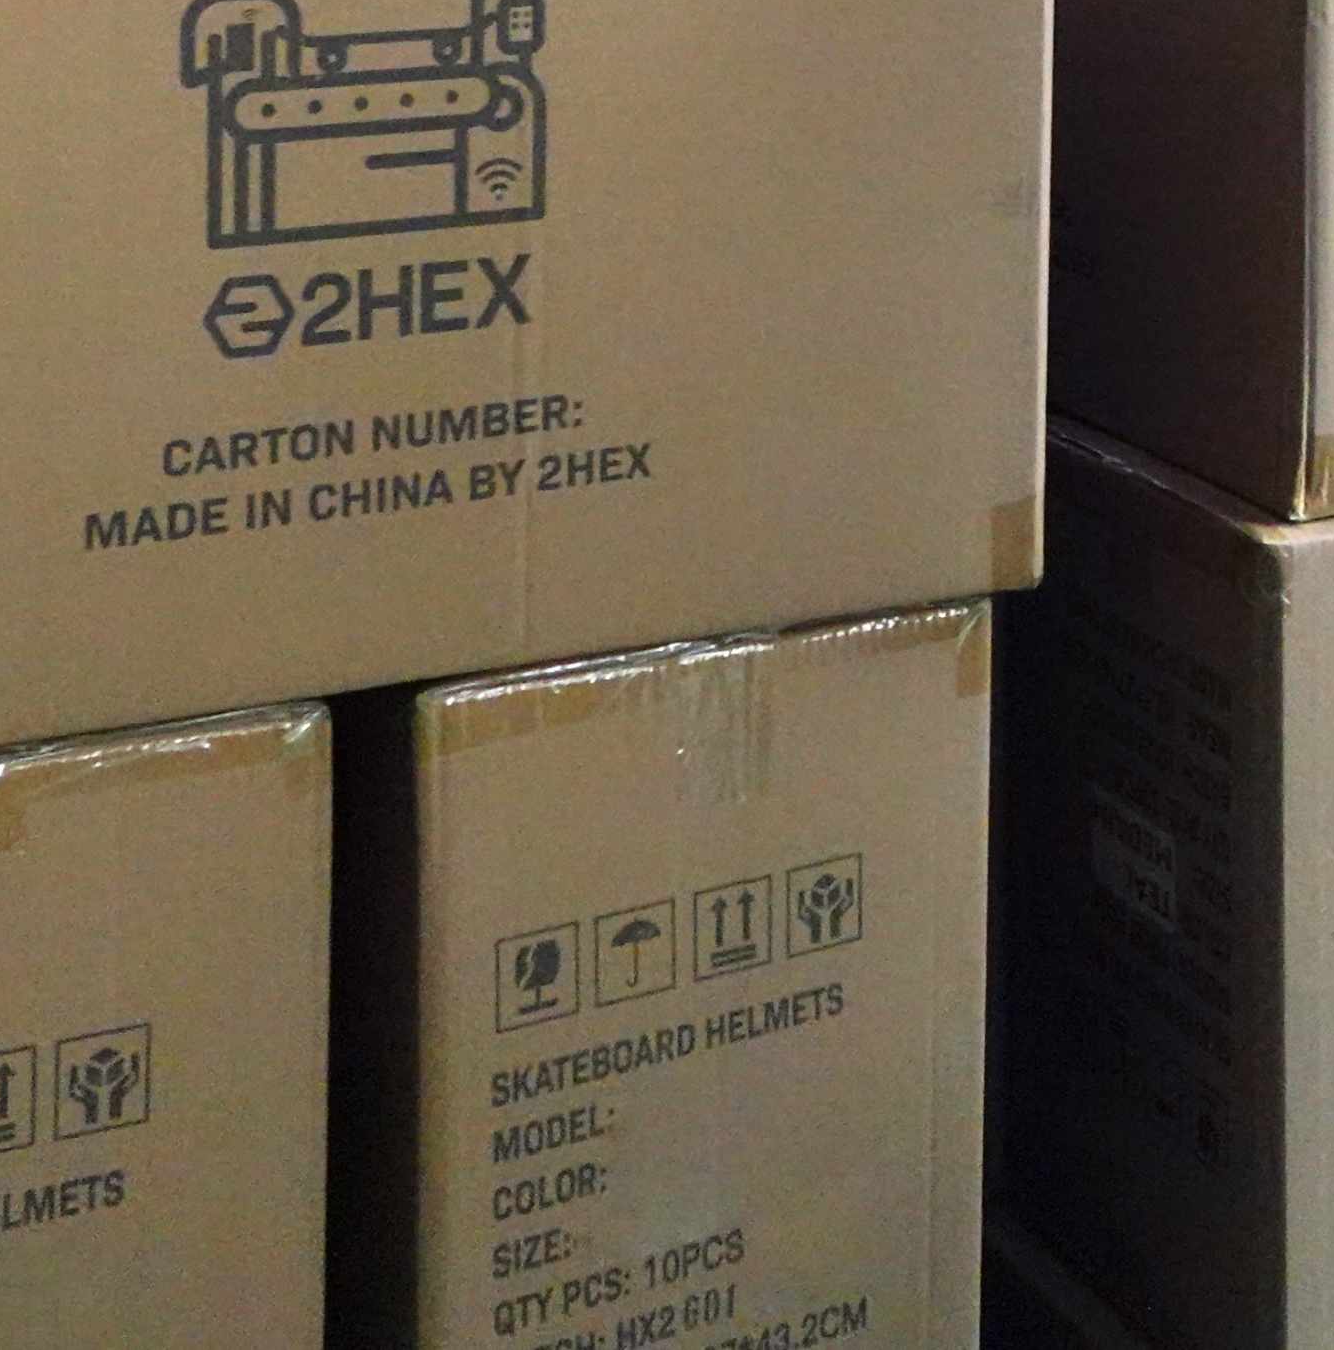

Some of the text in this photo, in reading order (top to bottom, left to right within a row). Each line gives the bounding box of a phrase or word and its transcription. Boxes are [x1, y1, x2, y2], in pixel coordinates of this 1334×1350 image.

[301, 254, 533, 346] 2HEX
[162, 394, 585, 478] CARTON NUMBER:
[85, 444, 653, 550] MADE IN CHINA BY 2HEX
[491, 983, 844, 1108] SKATEBOARD HELMETS
[492, 1104, 615, 1163] MODEL:
[492, 1165, 607, 1220] COLOR:
[492, 1228, 572, 1279] SIZE:
[493, 1228, 745, 1338] QTY PCS: 10PCS
